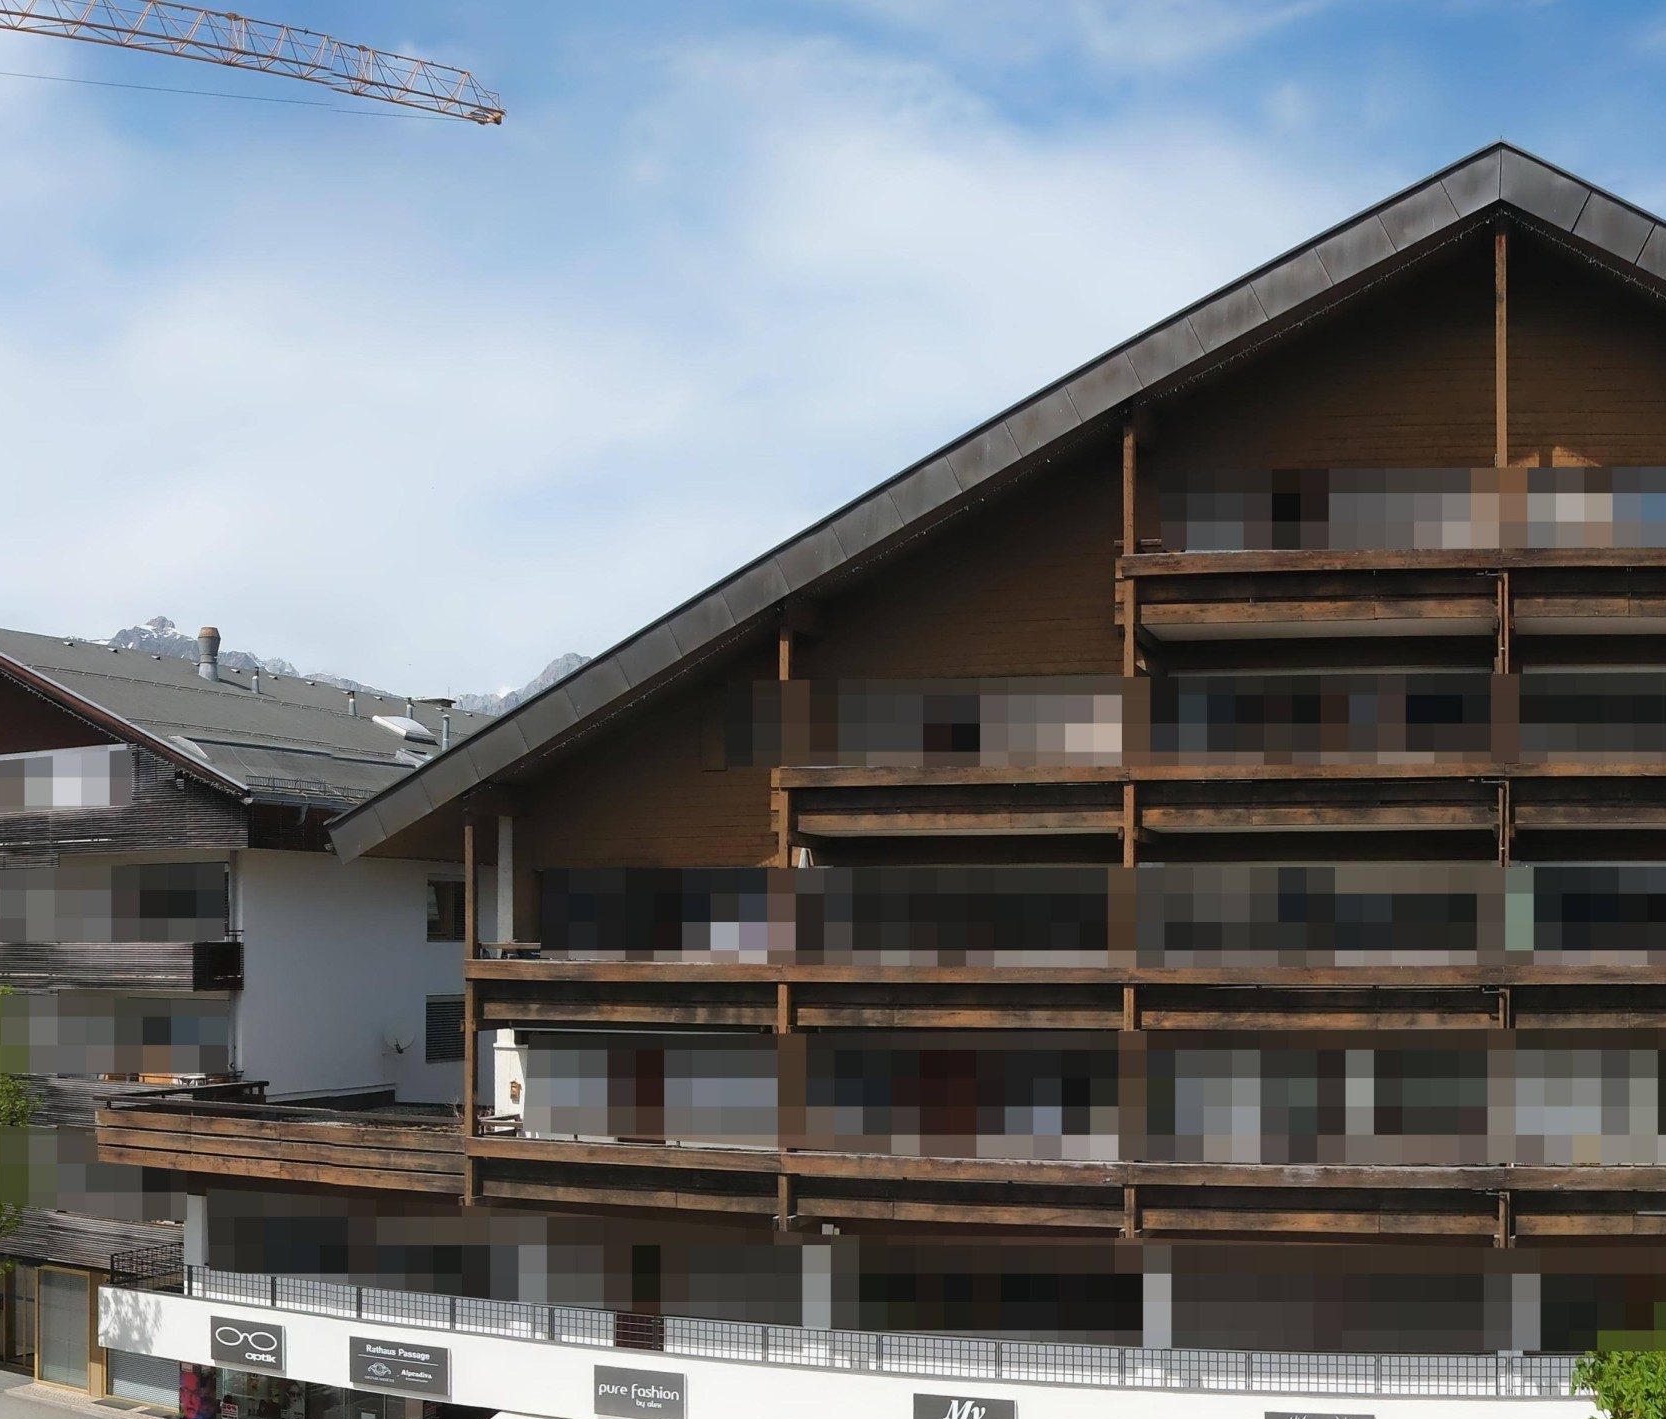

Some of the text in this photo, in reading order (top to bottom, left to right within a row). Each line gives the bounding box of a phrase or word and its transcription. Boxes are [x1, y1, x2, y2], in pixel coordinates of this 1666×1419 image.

[245, 1352, 276, 1364] optik
[366, 1344, 430, 1361] Rathaus Passage
[401, 1369, 432, 1380] Alpendiva
[598, 1383, 680, 1401] pure fashion
[636, 1399, 646, 1409] by
